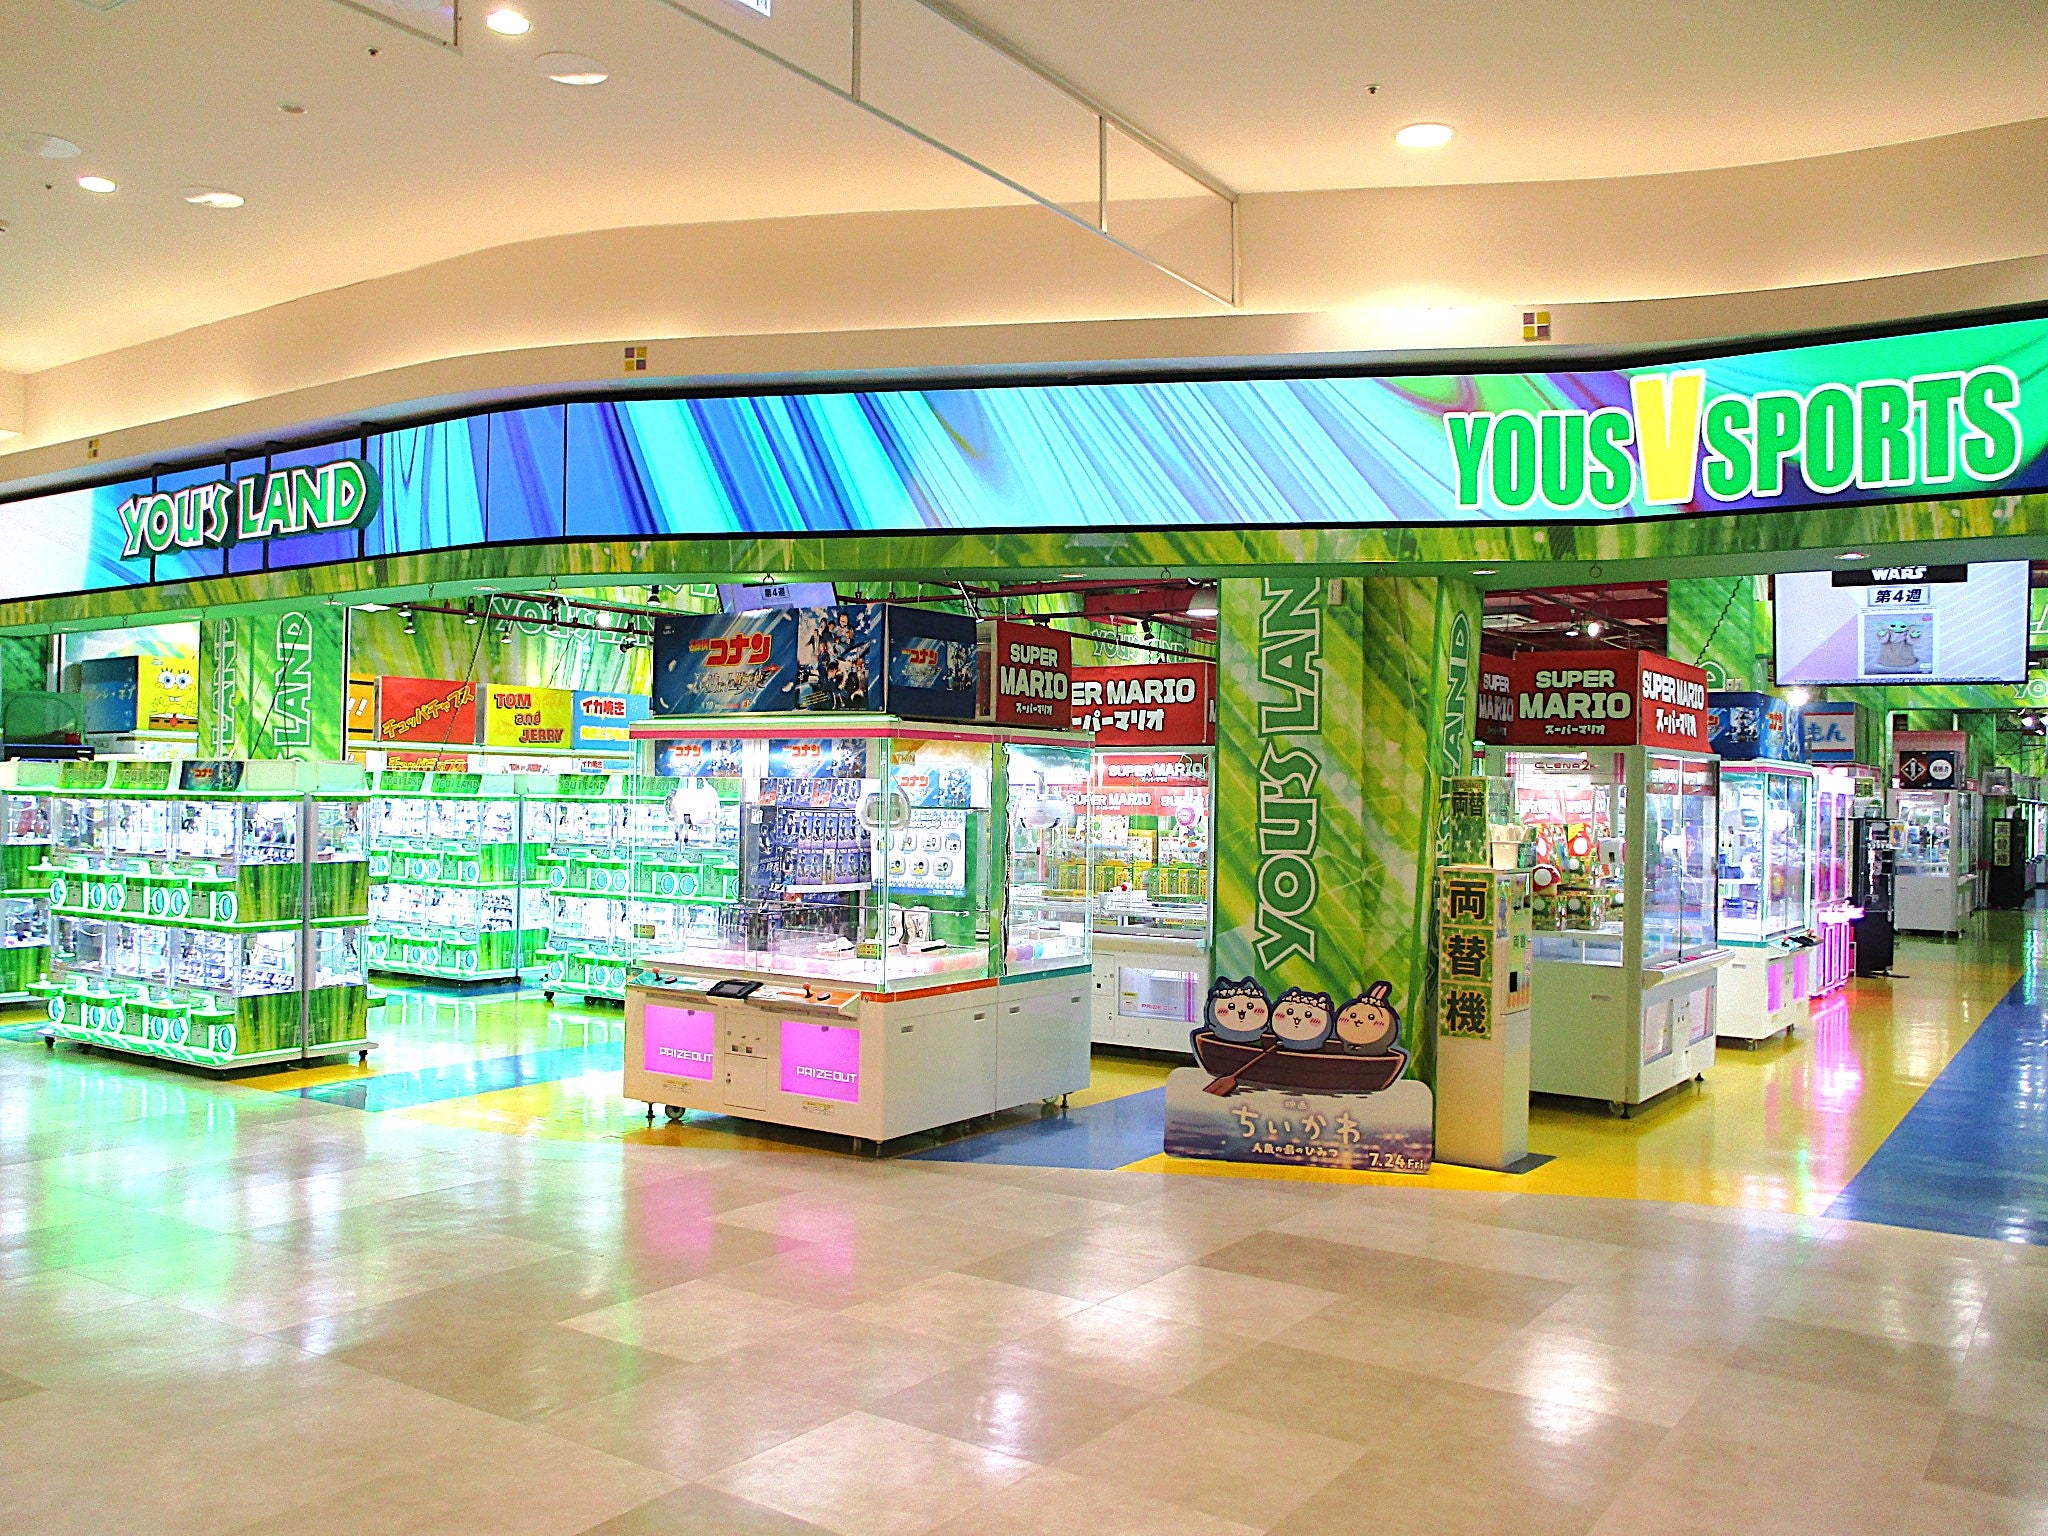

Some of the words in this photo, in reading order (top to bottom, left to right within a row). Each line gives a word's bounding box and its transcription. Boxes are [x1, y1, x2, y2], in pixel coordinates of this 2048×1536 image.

[117, 481, 234, 558] YOU'S
[237, 460, 368, 540] LAND
[1872, 567, 1927, 582] WARS
[1874, 588, 1923, 604] 第4週
[1010, 643, 1058, 668] SUPER
[274, 611, 313, 746] LAND
[1000, 665, 1068, 700] MARIO
[1483, 673, 1510, 694] SUPER
[1535, 669, 1616, 689] SUPER
[1642, 669, 1676, 705] SUPER
[1676, 678, 1705, 711] MARIO
[494, 692, 532, 709] TOM
[1107, 678, 1195, 705] MARIO
[582, 699, 626, 716] イカ焼き
[1015, 702, 1053, 716] スーパーマリオ
[1478, 693, 1514, 722] MARIO
[1519, 692, 1632, 720] MARIO
[514, 710, 542, 726] and
[1544, 724, 1606, 735] スーパーマリオ
[519, 728, 565, 744] JERRY
[1453, 791, 1485, 818] 両替
[1446, 880, 1488, 1035] 両替機
[1285, 1100, 1308, 1110] 映画
[1231, 1106, 1362, 1145] ちいかわ
